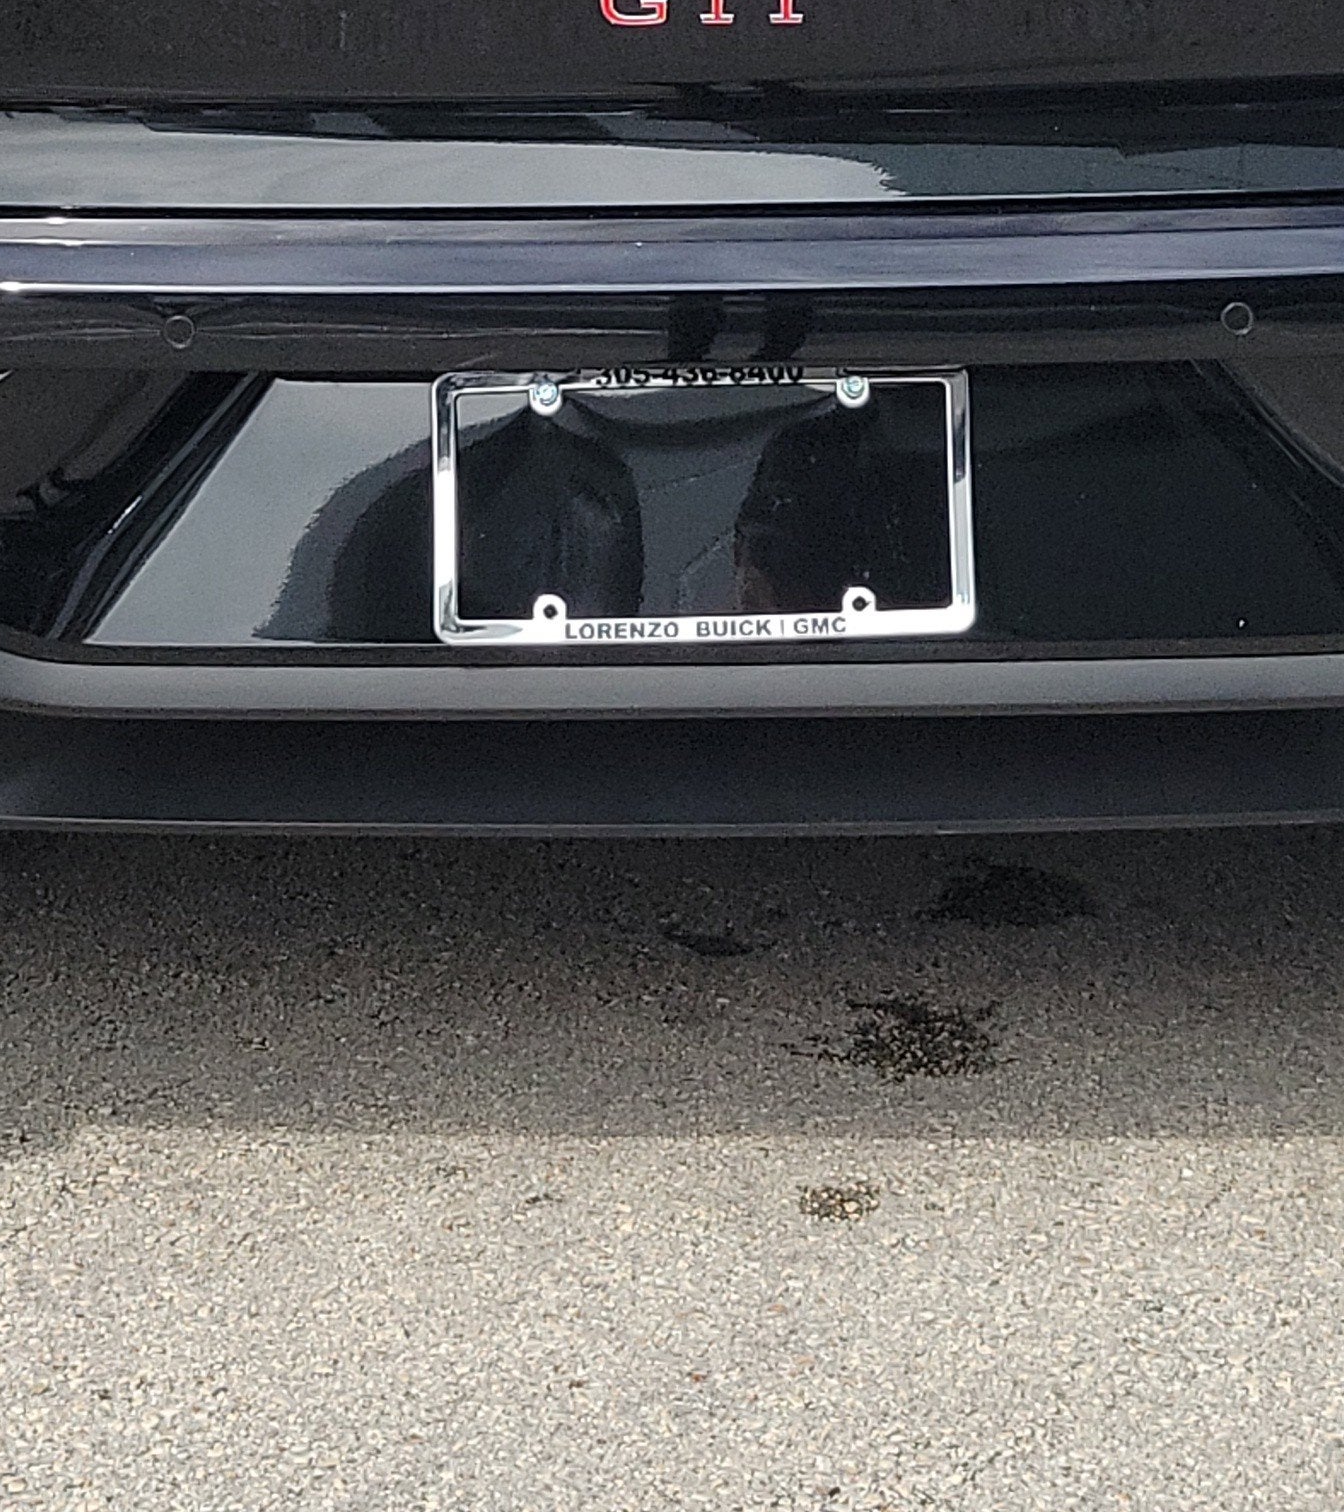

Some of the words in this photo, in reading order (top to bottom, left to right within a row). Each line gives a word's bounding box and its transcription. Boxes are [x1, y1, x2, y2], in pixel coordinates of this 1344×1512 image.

[564, 621, 680, 640] LORENZO
[695, 618, 773, 638] BUICK
[792, 616, 847, 635] GMC
